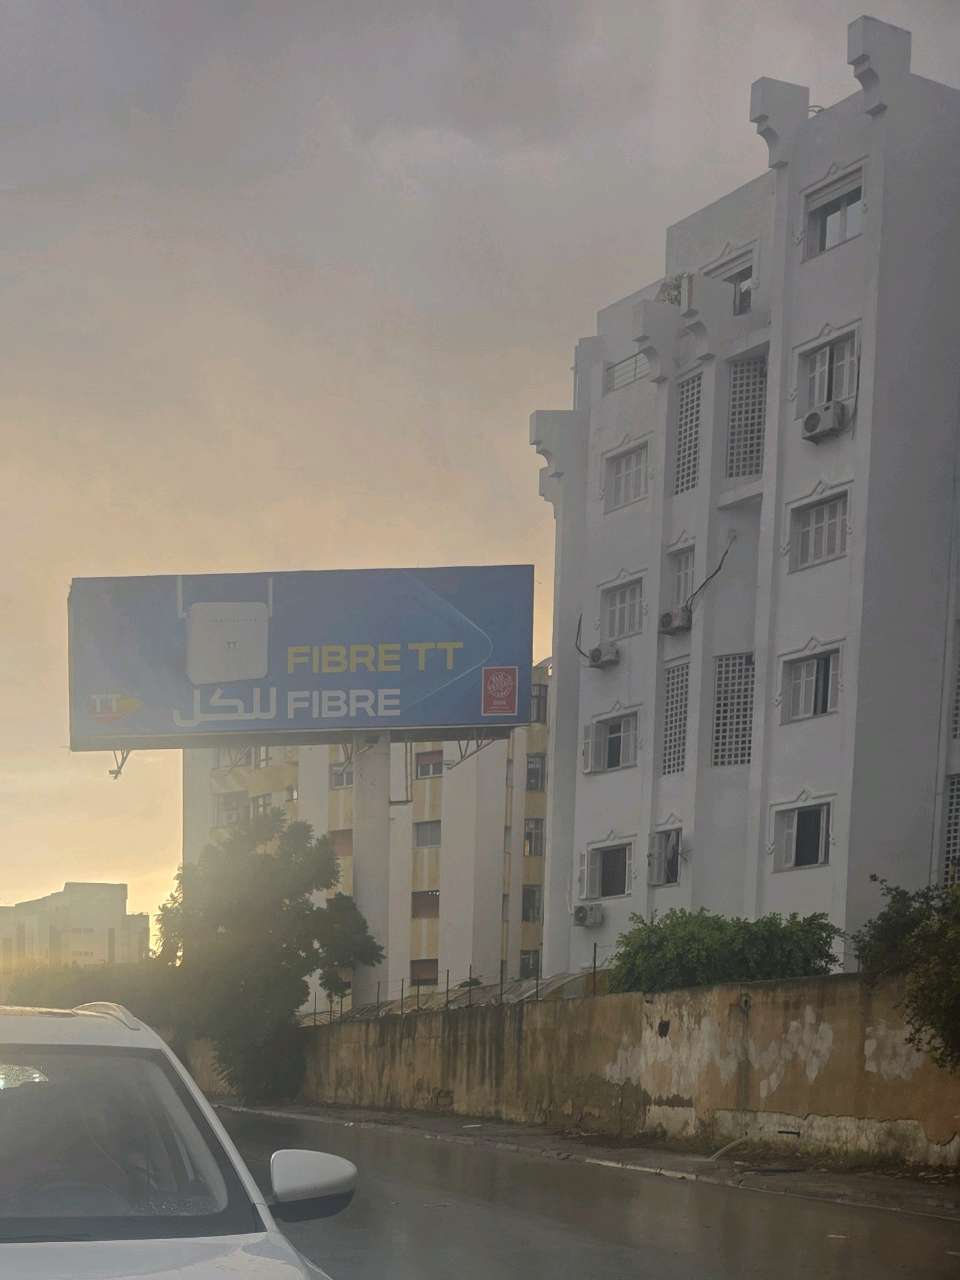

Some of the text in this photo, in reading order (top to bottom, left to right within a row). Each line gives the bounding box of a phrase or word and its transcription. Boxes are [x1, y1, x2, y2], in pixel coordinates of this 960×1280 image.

[288, 641, 464, 673] FIBRE TT
[90, 693, 121, 713] TT
[173, 687, 277, 727] للكل
[288, 688, 401, 719] FIBRE
